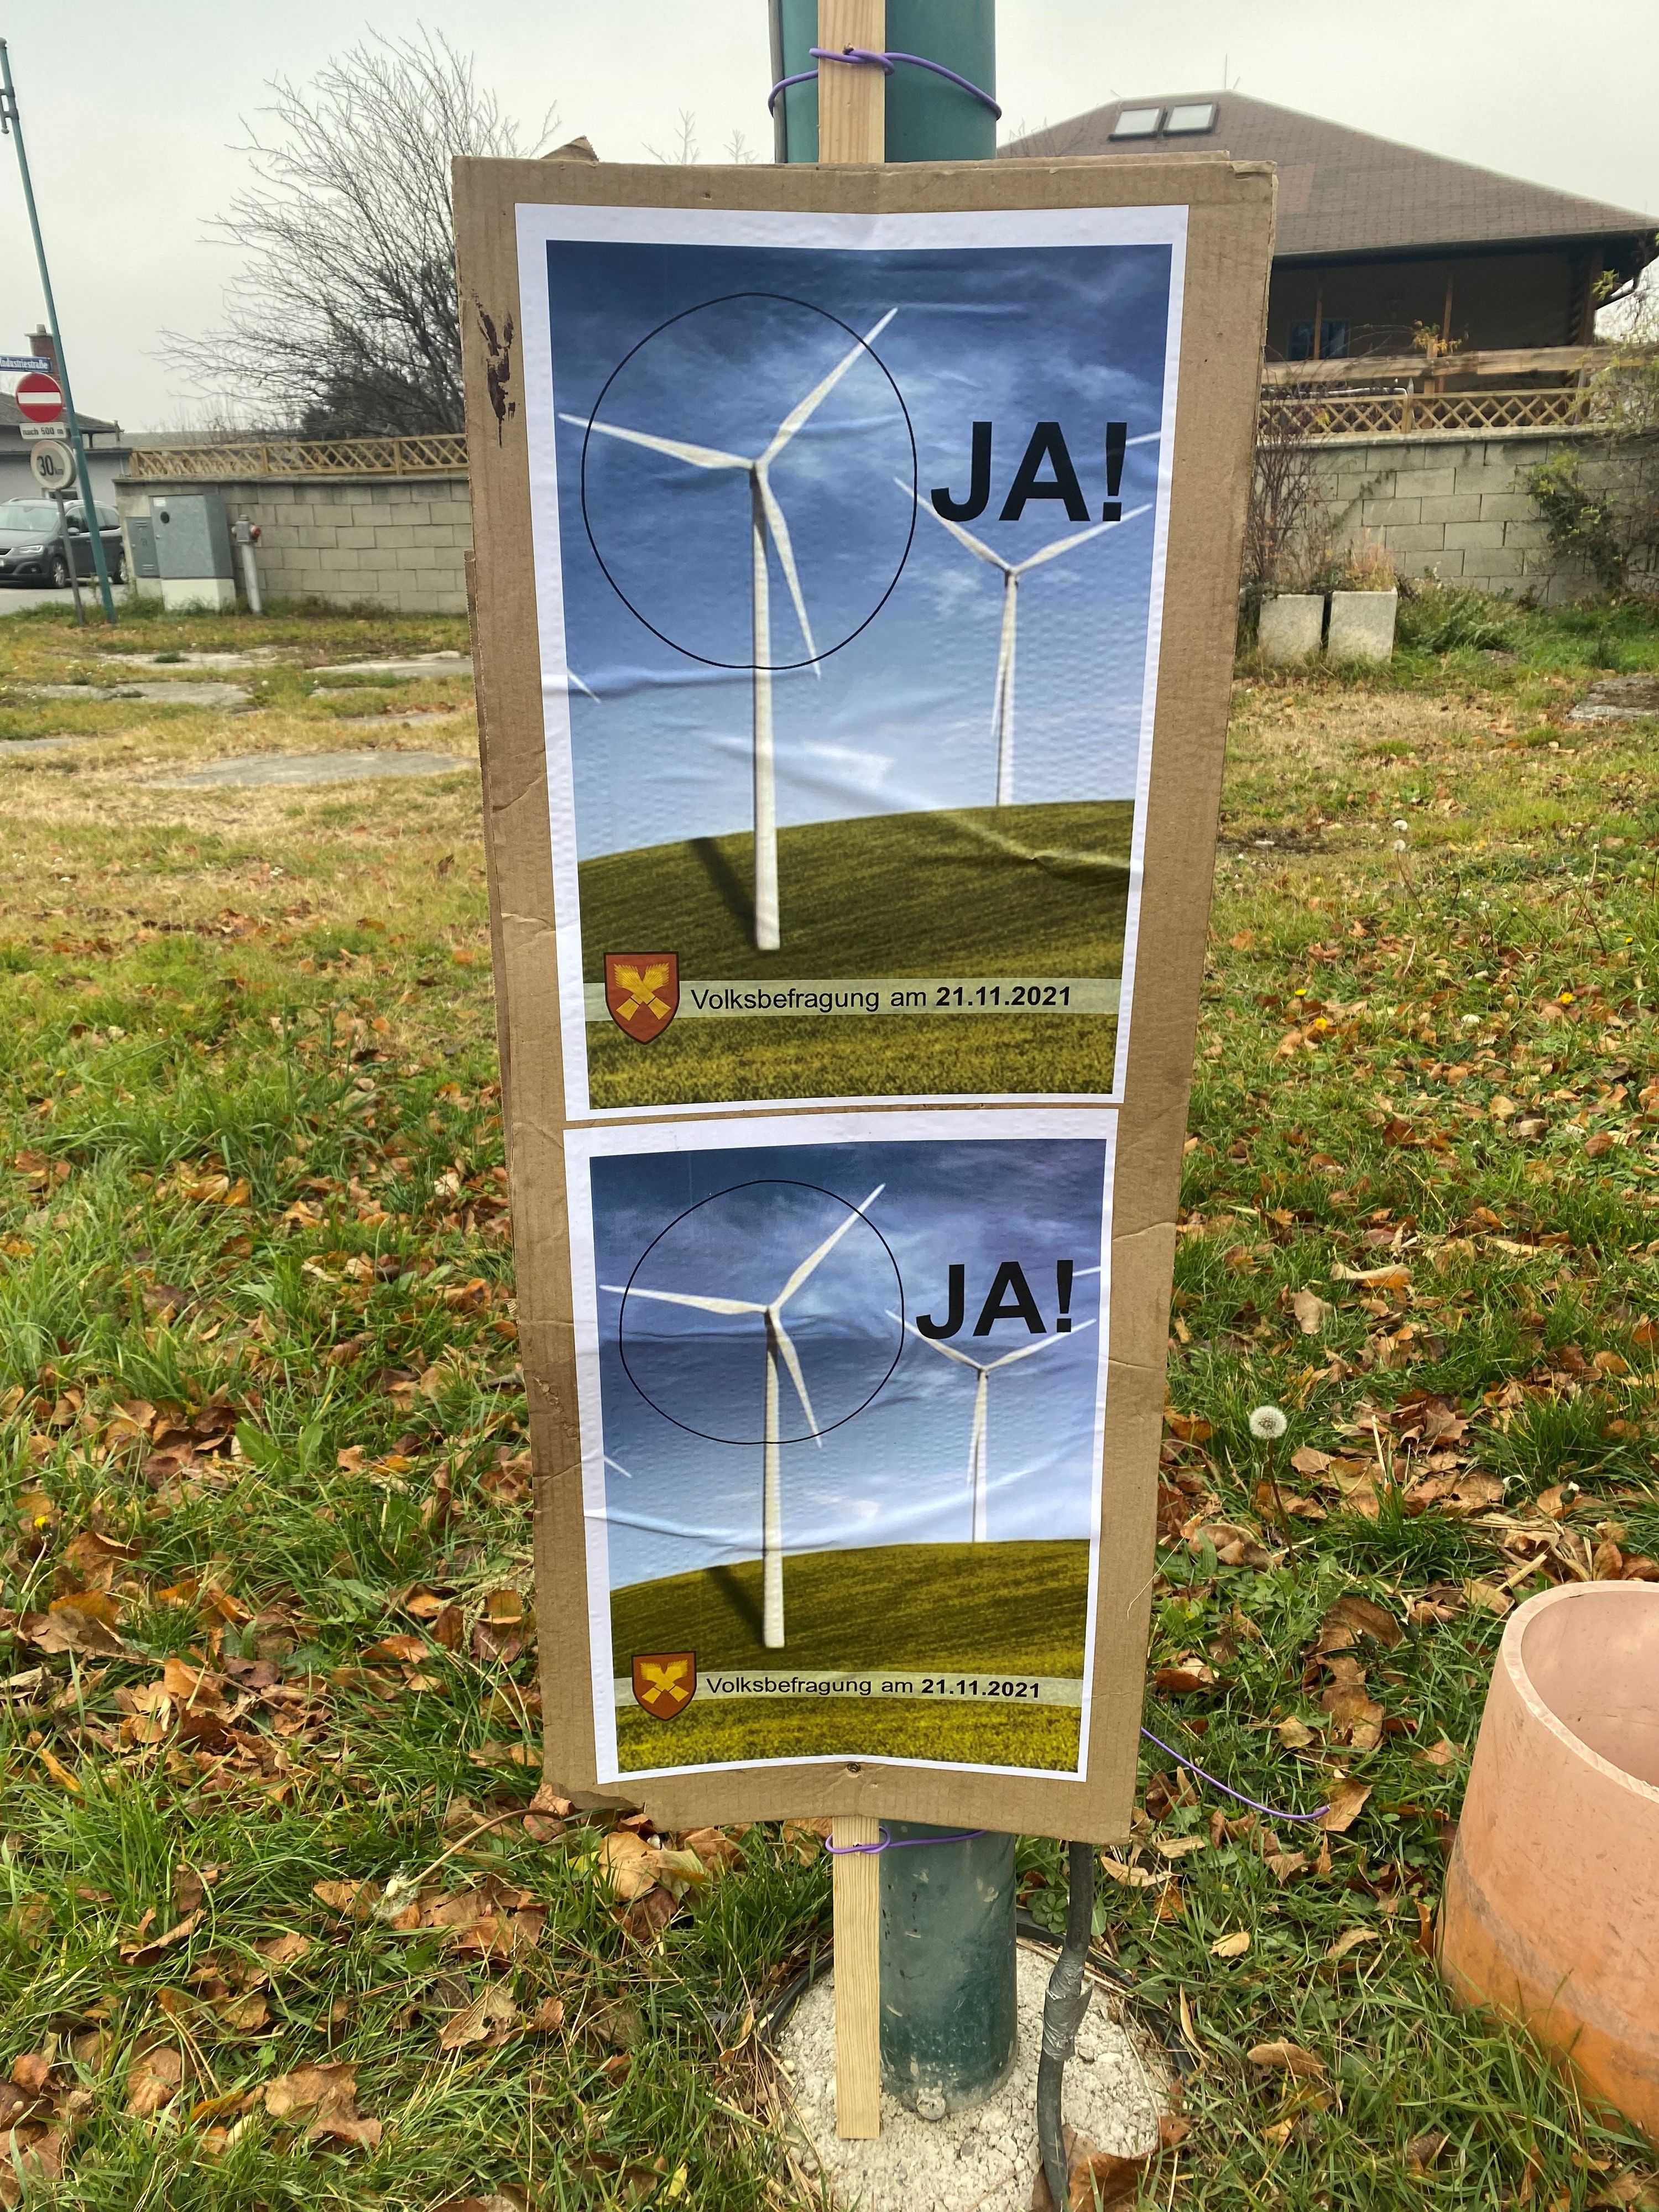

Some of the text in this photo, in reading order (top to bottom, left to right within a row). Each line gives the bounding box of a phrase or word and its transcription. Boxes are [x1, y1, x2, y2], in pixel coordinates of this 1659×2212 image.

[36, 455, 54, 476] 30
[930, 421, 1128, 522] JA!
[690, 985, 1071, 1013] Volksbefragung am 21.11.2021
[915, 1259, 1074, 1340] JA!
[706, 1676, 1040, 1699] Volksbefragung am 21.11.2021
